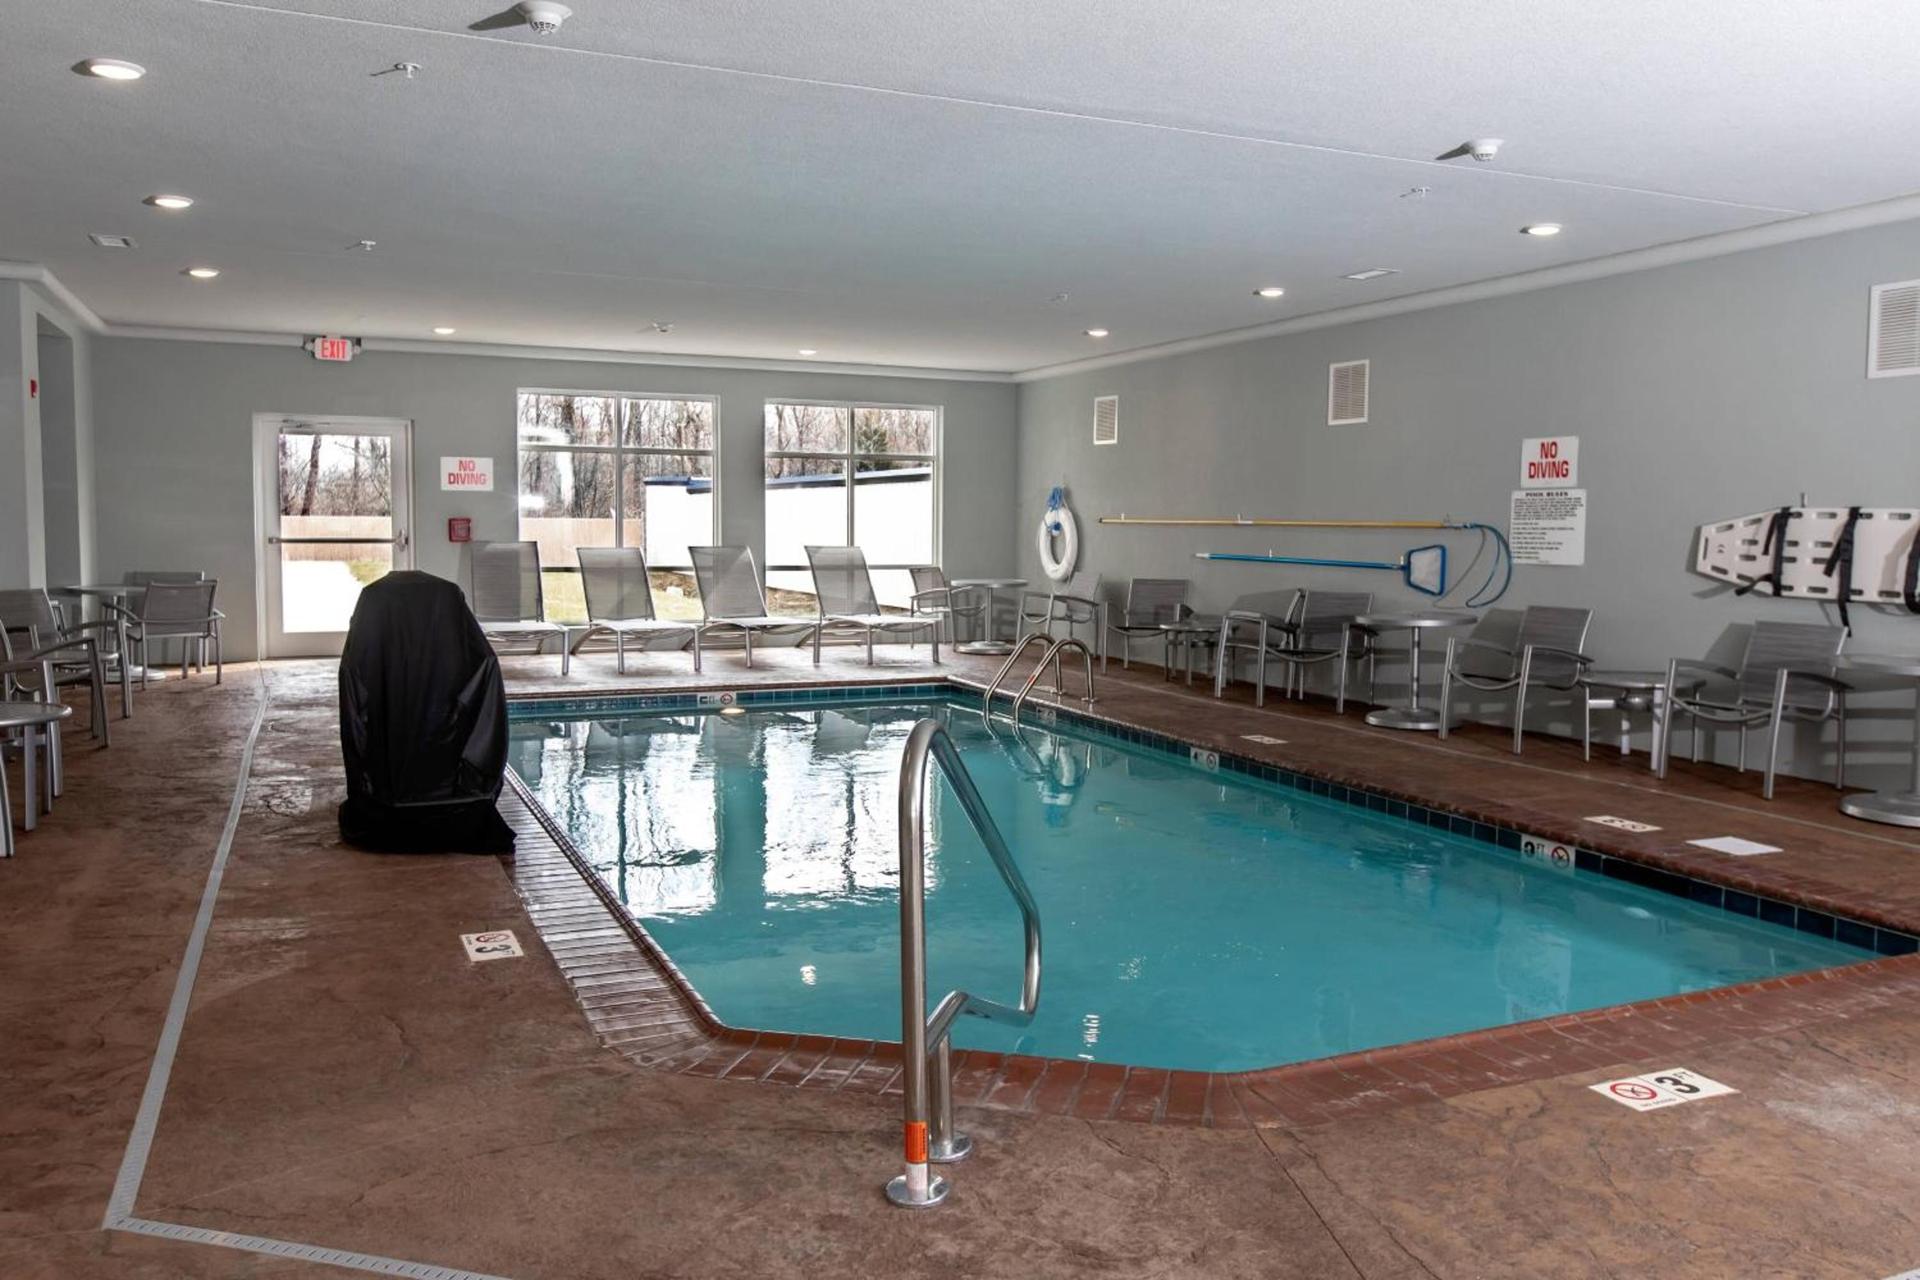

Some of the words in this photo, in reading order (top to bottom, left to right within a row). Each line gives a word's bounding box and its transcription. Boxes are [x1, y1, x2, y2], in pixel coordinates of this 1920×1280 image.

[321, 339, 348, 359] EXIT
[1540, 441, 1558, 459] NO
[458, 460, 476, 472] NO
[1528, 460, 1569, 479] DIVING
[447, 472, 487, 485] DIVING
[475, 944, 512, 953] 3
[1654, 1076, 1701, 1094] 3
